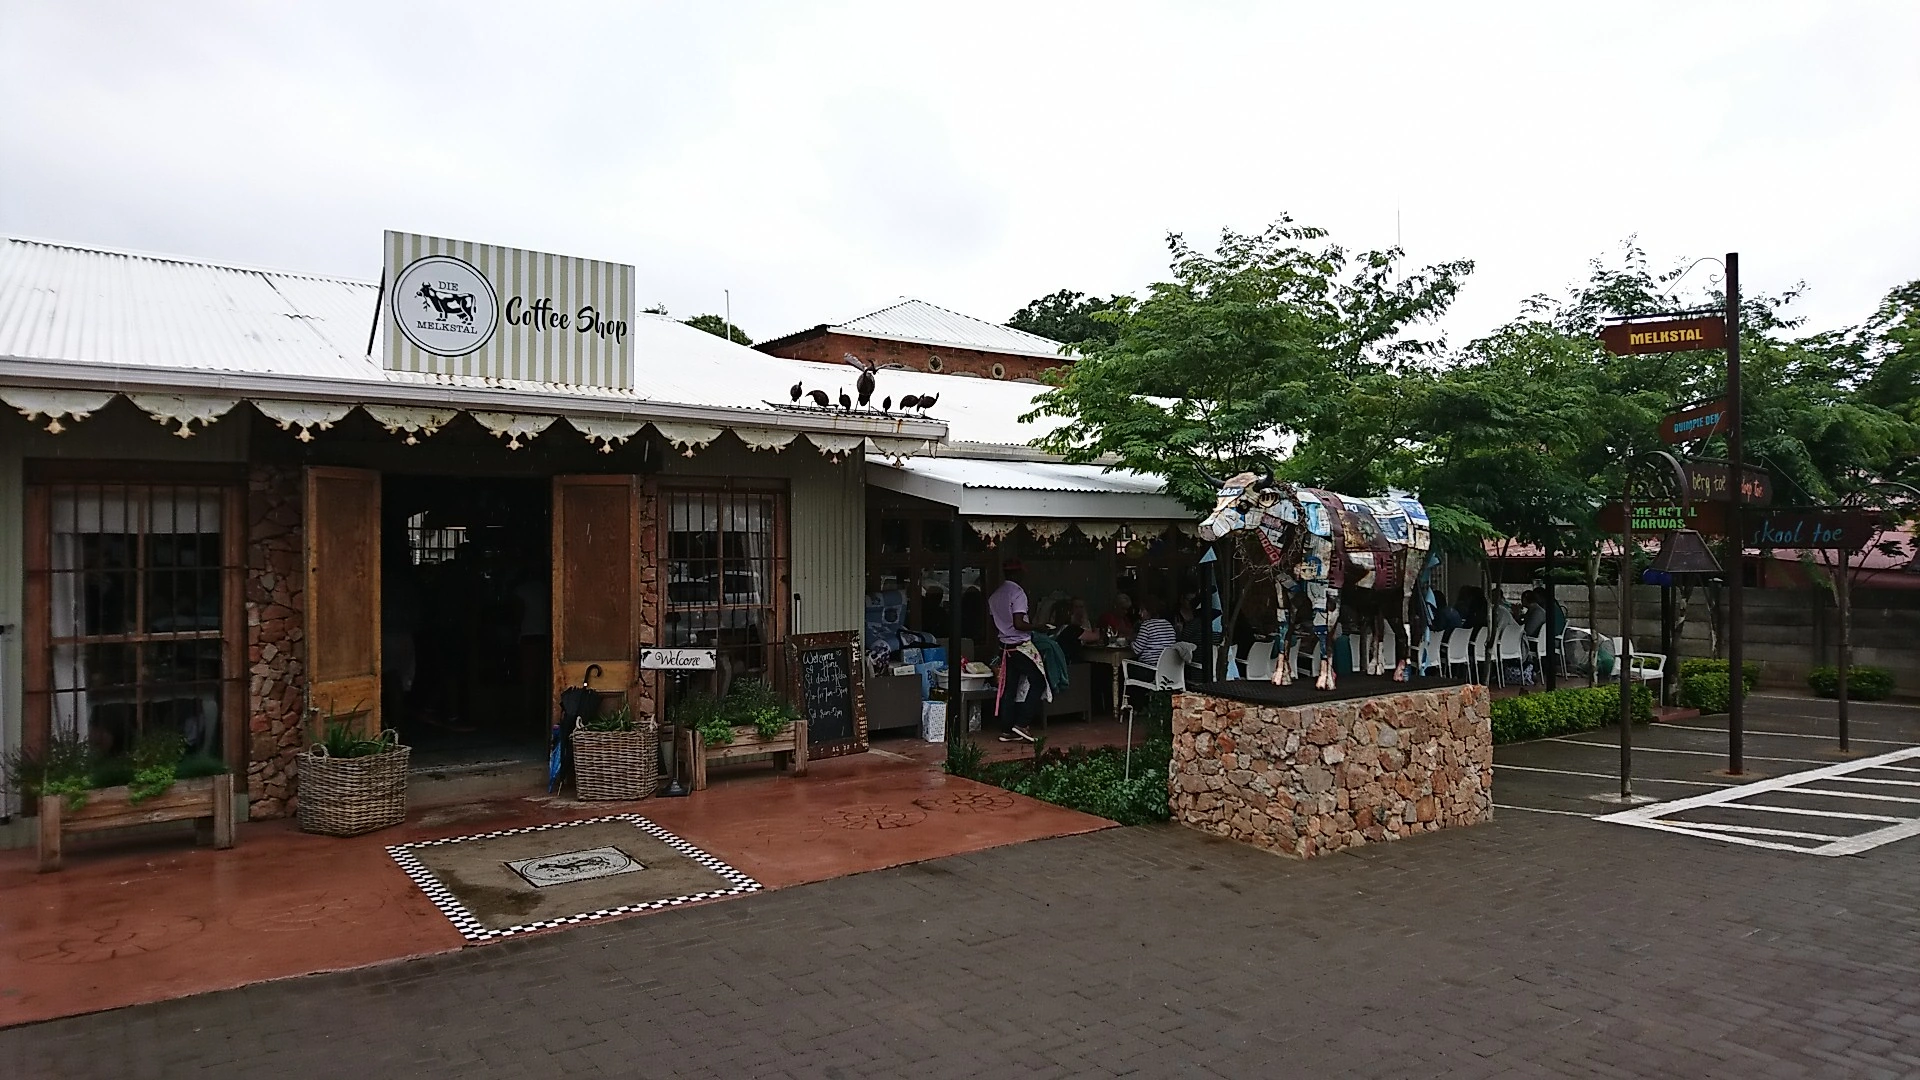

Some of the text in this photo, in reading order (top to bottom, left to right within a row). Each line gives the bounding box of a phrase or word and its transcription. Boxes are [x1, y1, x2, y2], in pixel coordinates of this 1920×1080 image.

[438, 281, 459, 292] DIE
[416, 320, 478, 335] MELKSTAL
[505, 296, 628, 345] Coffee Shop
[1630, 328, 1704, 346] MELKSTAL
[1692, 470, 1727, 497] berg toe
[1631, 518, 1685, 529] KARWAS
[1752, 519, 1843, 545] skool toe
[654, 650, 701, 667] Welcome
[802, 651, 836, 665] Welcome
